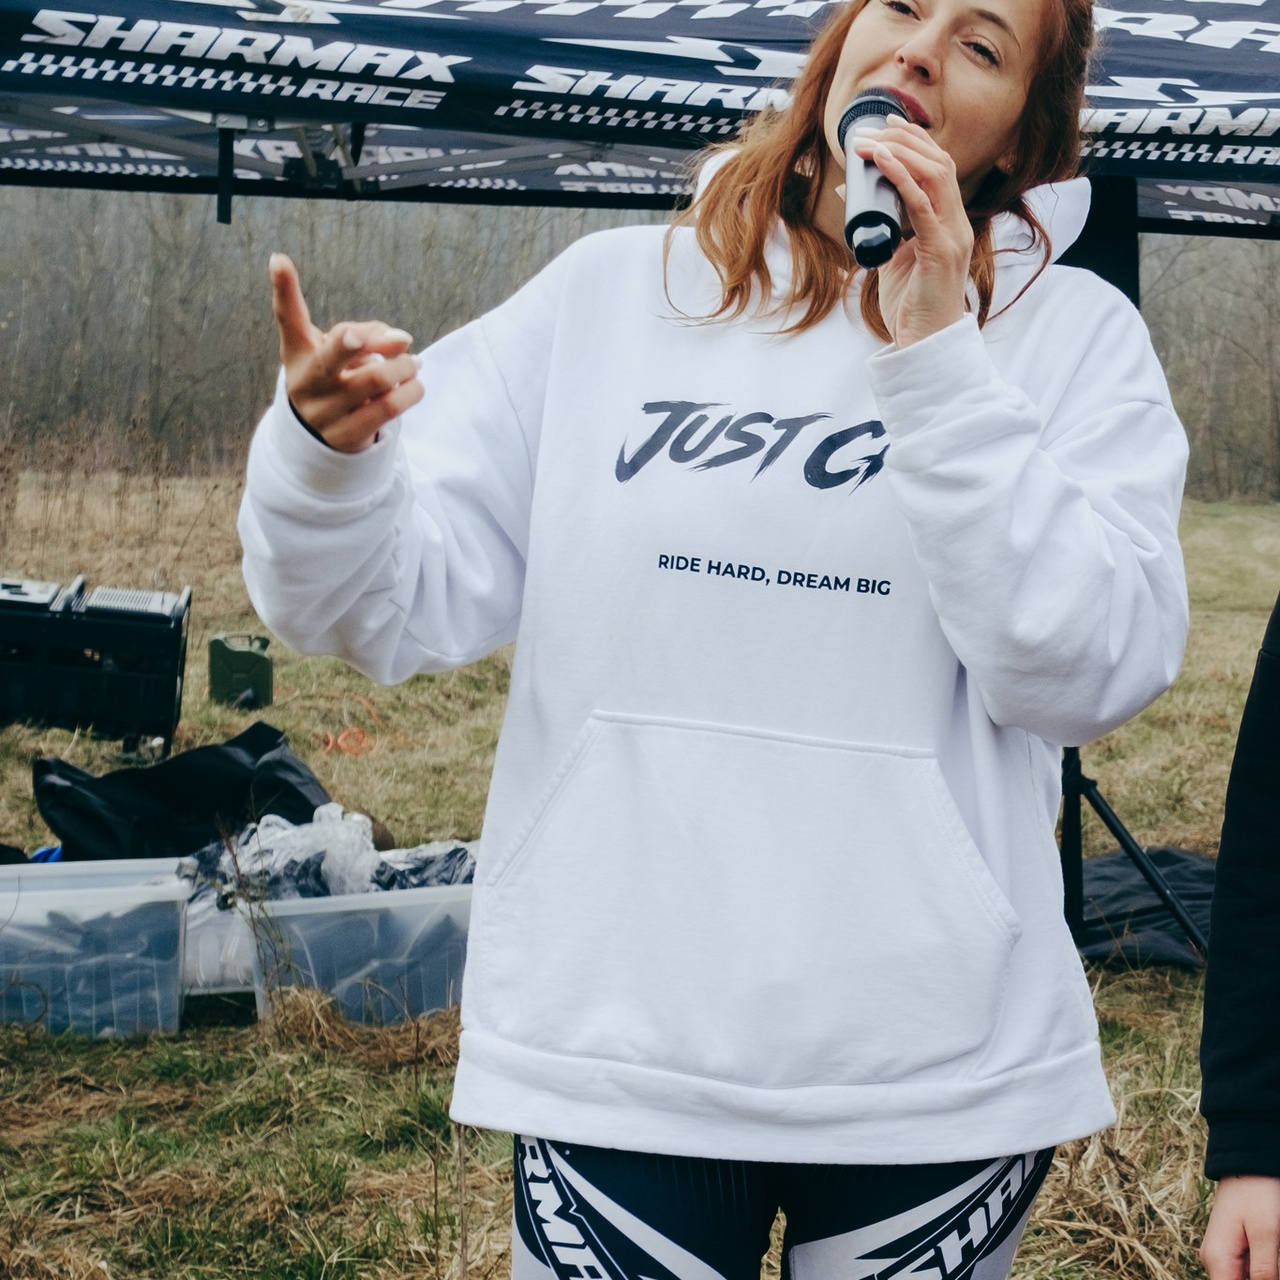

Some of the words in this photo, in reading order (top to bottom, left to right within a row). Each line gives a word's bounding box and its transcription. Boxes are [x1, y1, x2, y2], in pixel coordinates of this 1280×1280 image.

[20, 9, 473, 83] SHARMAX
[297, 78, 447, 110] RACE
[614, 400, 834, 483] JUST
[658, 554, 702, 573] RIDE
[707, 560, 771, 586] HARD,
[776, 569, 850, 592] DREAM
[856, 578, 892, 596] BIG
